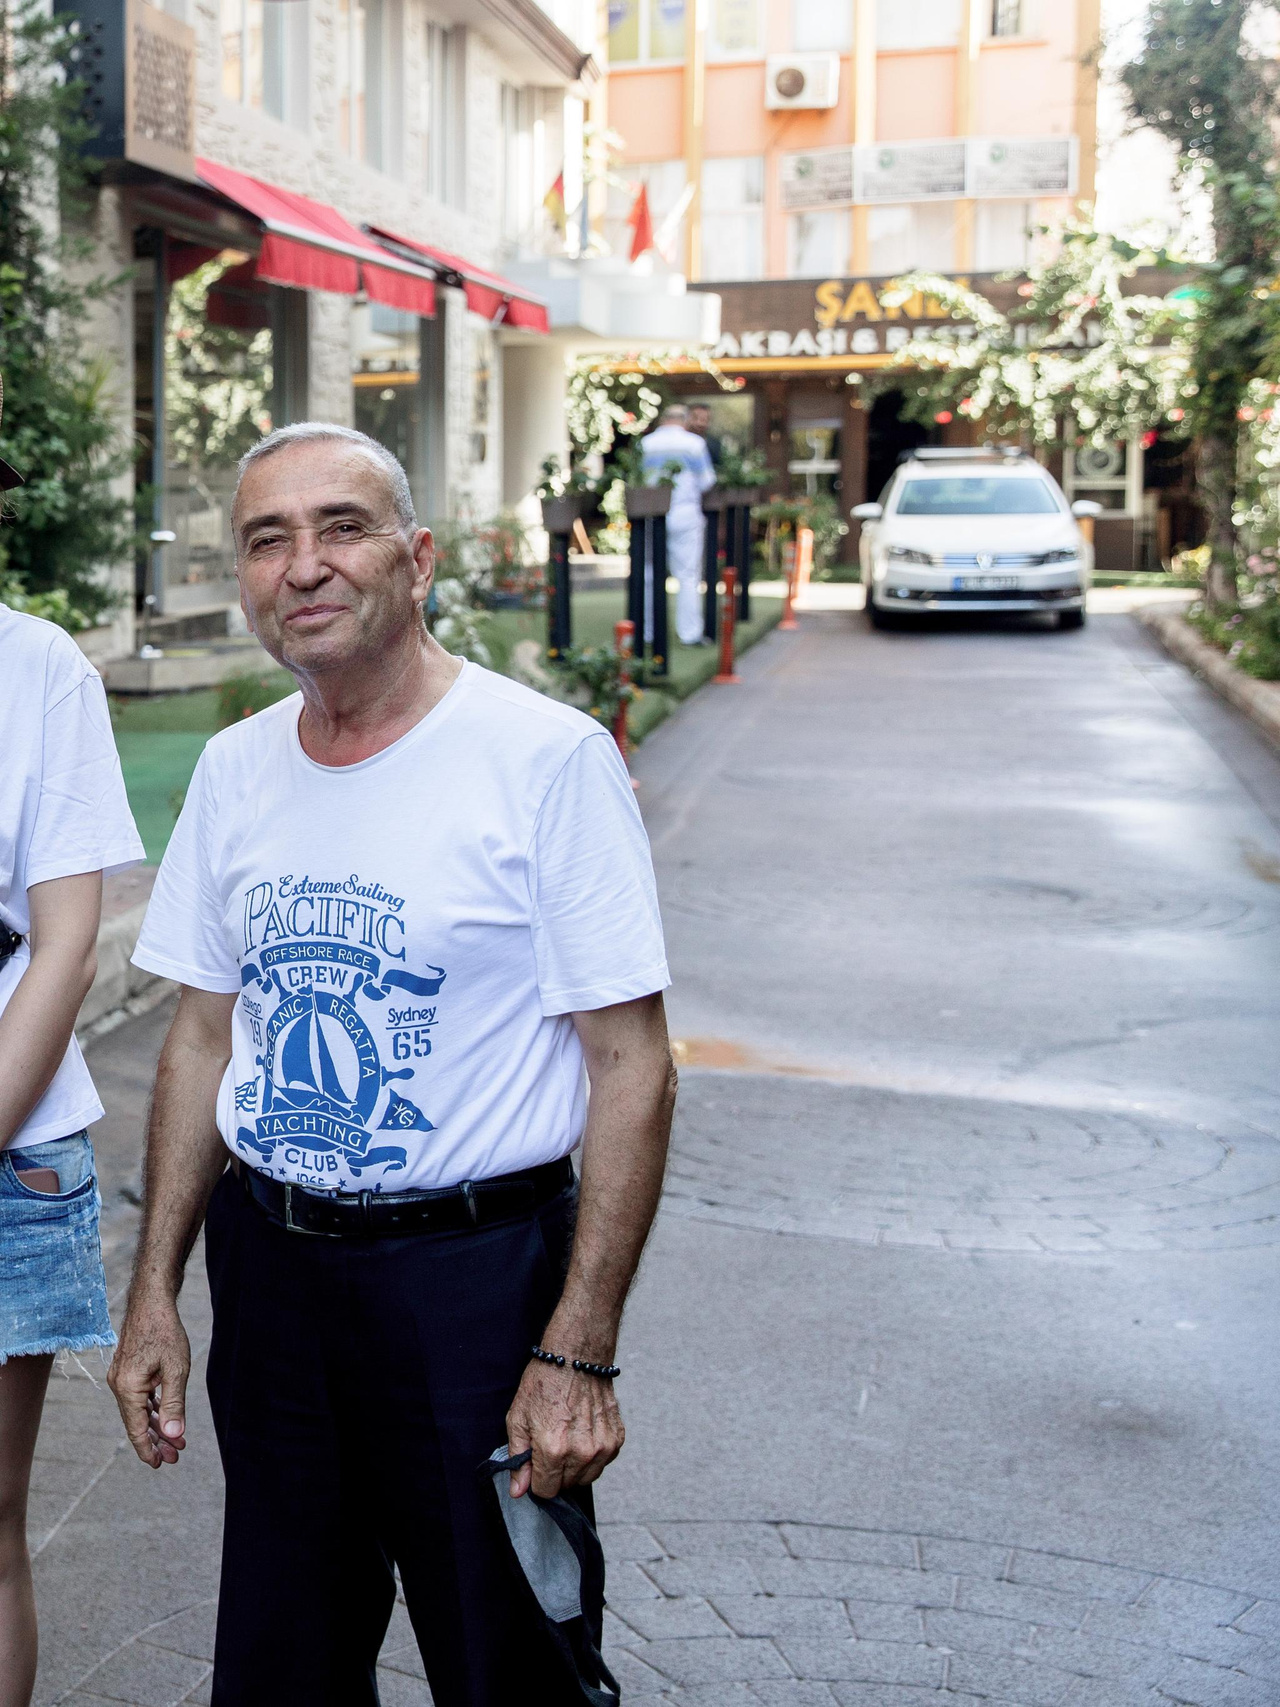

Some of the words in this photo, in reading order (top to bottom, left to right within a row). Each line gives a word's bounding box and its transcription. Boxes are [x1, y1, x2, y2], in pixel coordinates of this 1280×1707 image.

[851, 328, 879, 353] &
[278, 875, 342, 898] Extreme
[342, 874, 405, 912] Sailing
[244, 882, 406, 962] PACIFIC
[265, 946, 334, 964] OFFSHORE
[338, 948, 373, 969] RACE
[287, 966, 349, 988] CREW
[387, 1006, 437, 1026] Sydney
[266, 998, 304, 1069] OCEANIC
[329, 998, 377, 1079] REGATTA
[392, 1028, 432, 1060] 65
[261, 1116, 363, 1147] YACHTING
[284, 1147, 339, 1172] CLUB
